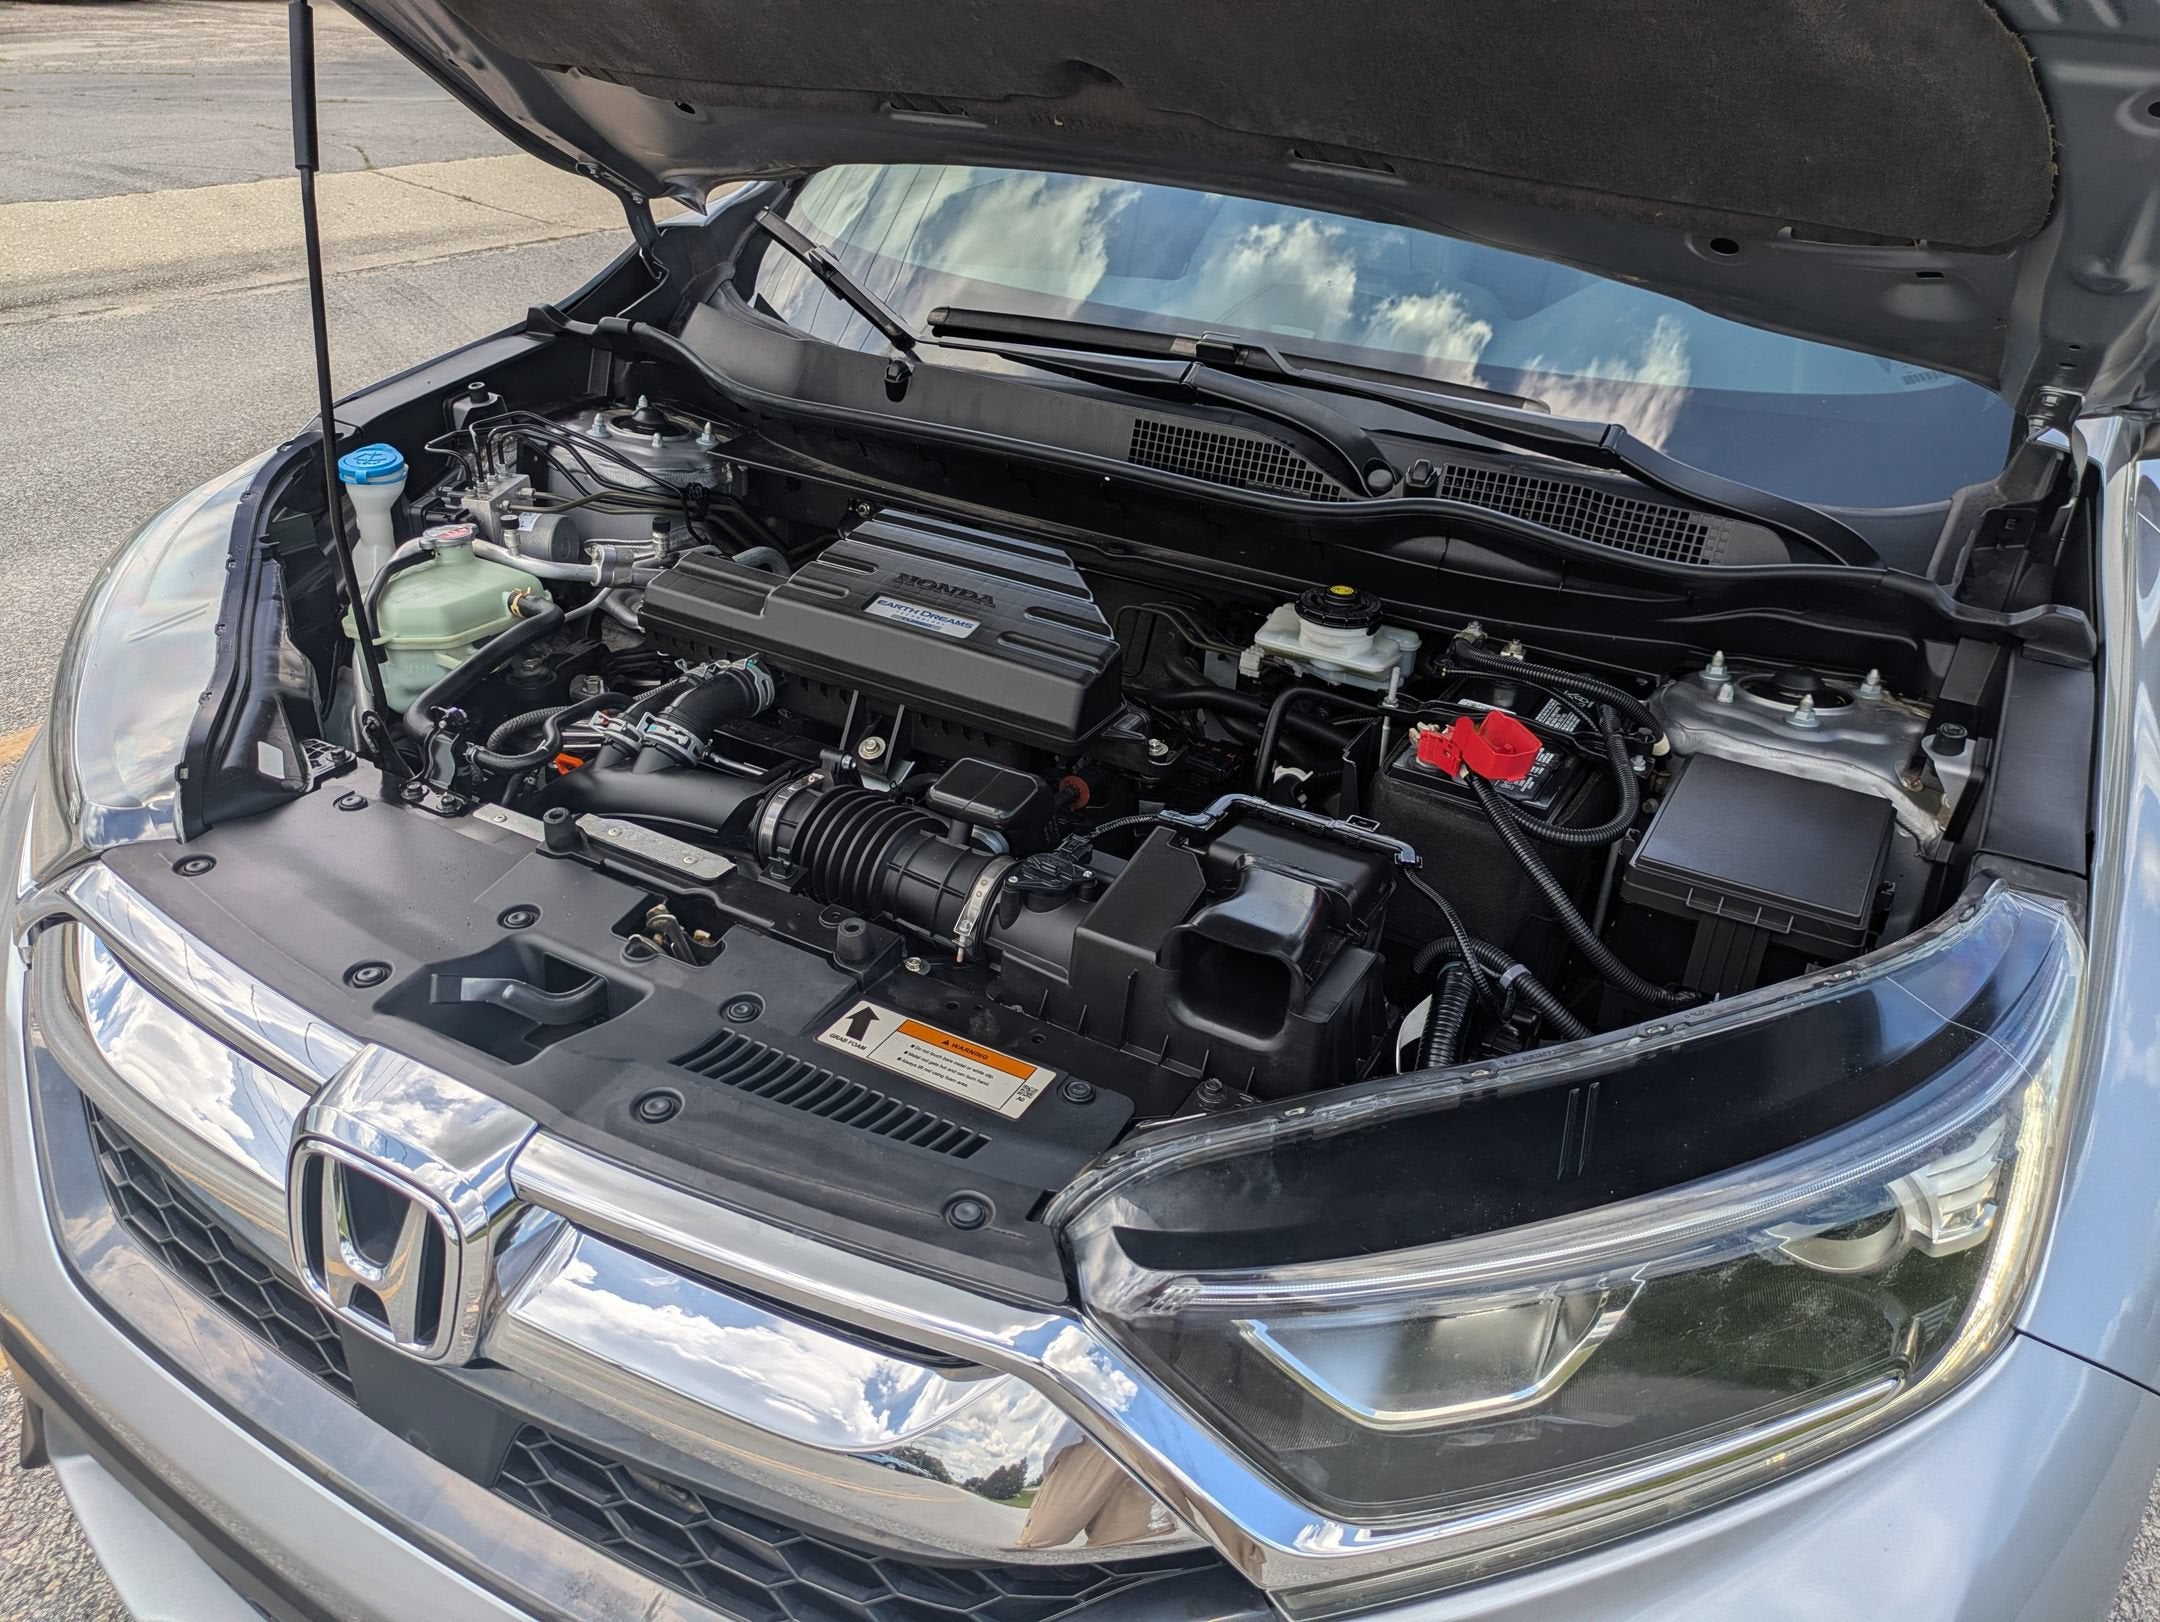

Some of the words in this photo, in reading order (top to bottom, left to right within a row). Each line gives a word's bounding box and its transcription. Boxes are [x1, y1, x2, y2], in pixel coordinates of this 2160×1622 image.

[893, 572, 996, 608] HONDA
[877, 599, 919, 615] EARTH
[920, 610, 974, 629] DREAMS
[902, 617, 934, 628] TURBO
[829, 1033, 848, 1044] GRAB
[847, 1040, 867, 1051] FOAM
[951, 1042, 989, 1060] WARNING
[930, 1051, 942, 1059] touch
[901, 1058, 917, 1067] Always
[932, 1071, 944, 1079] using
